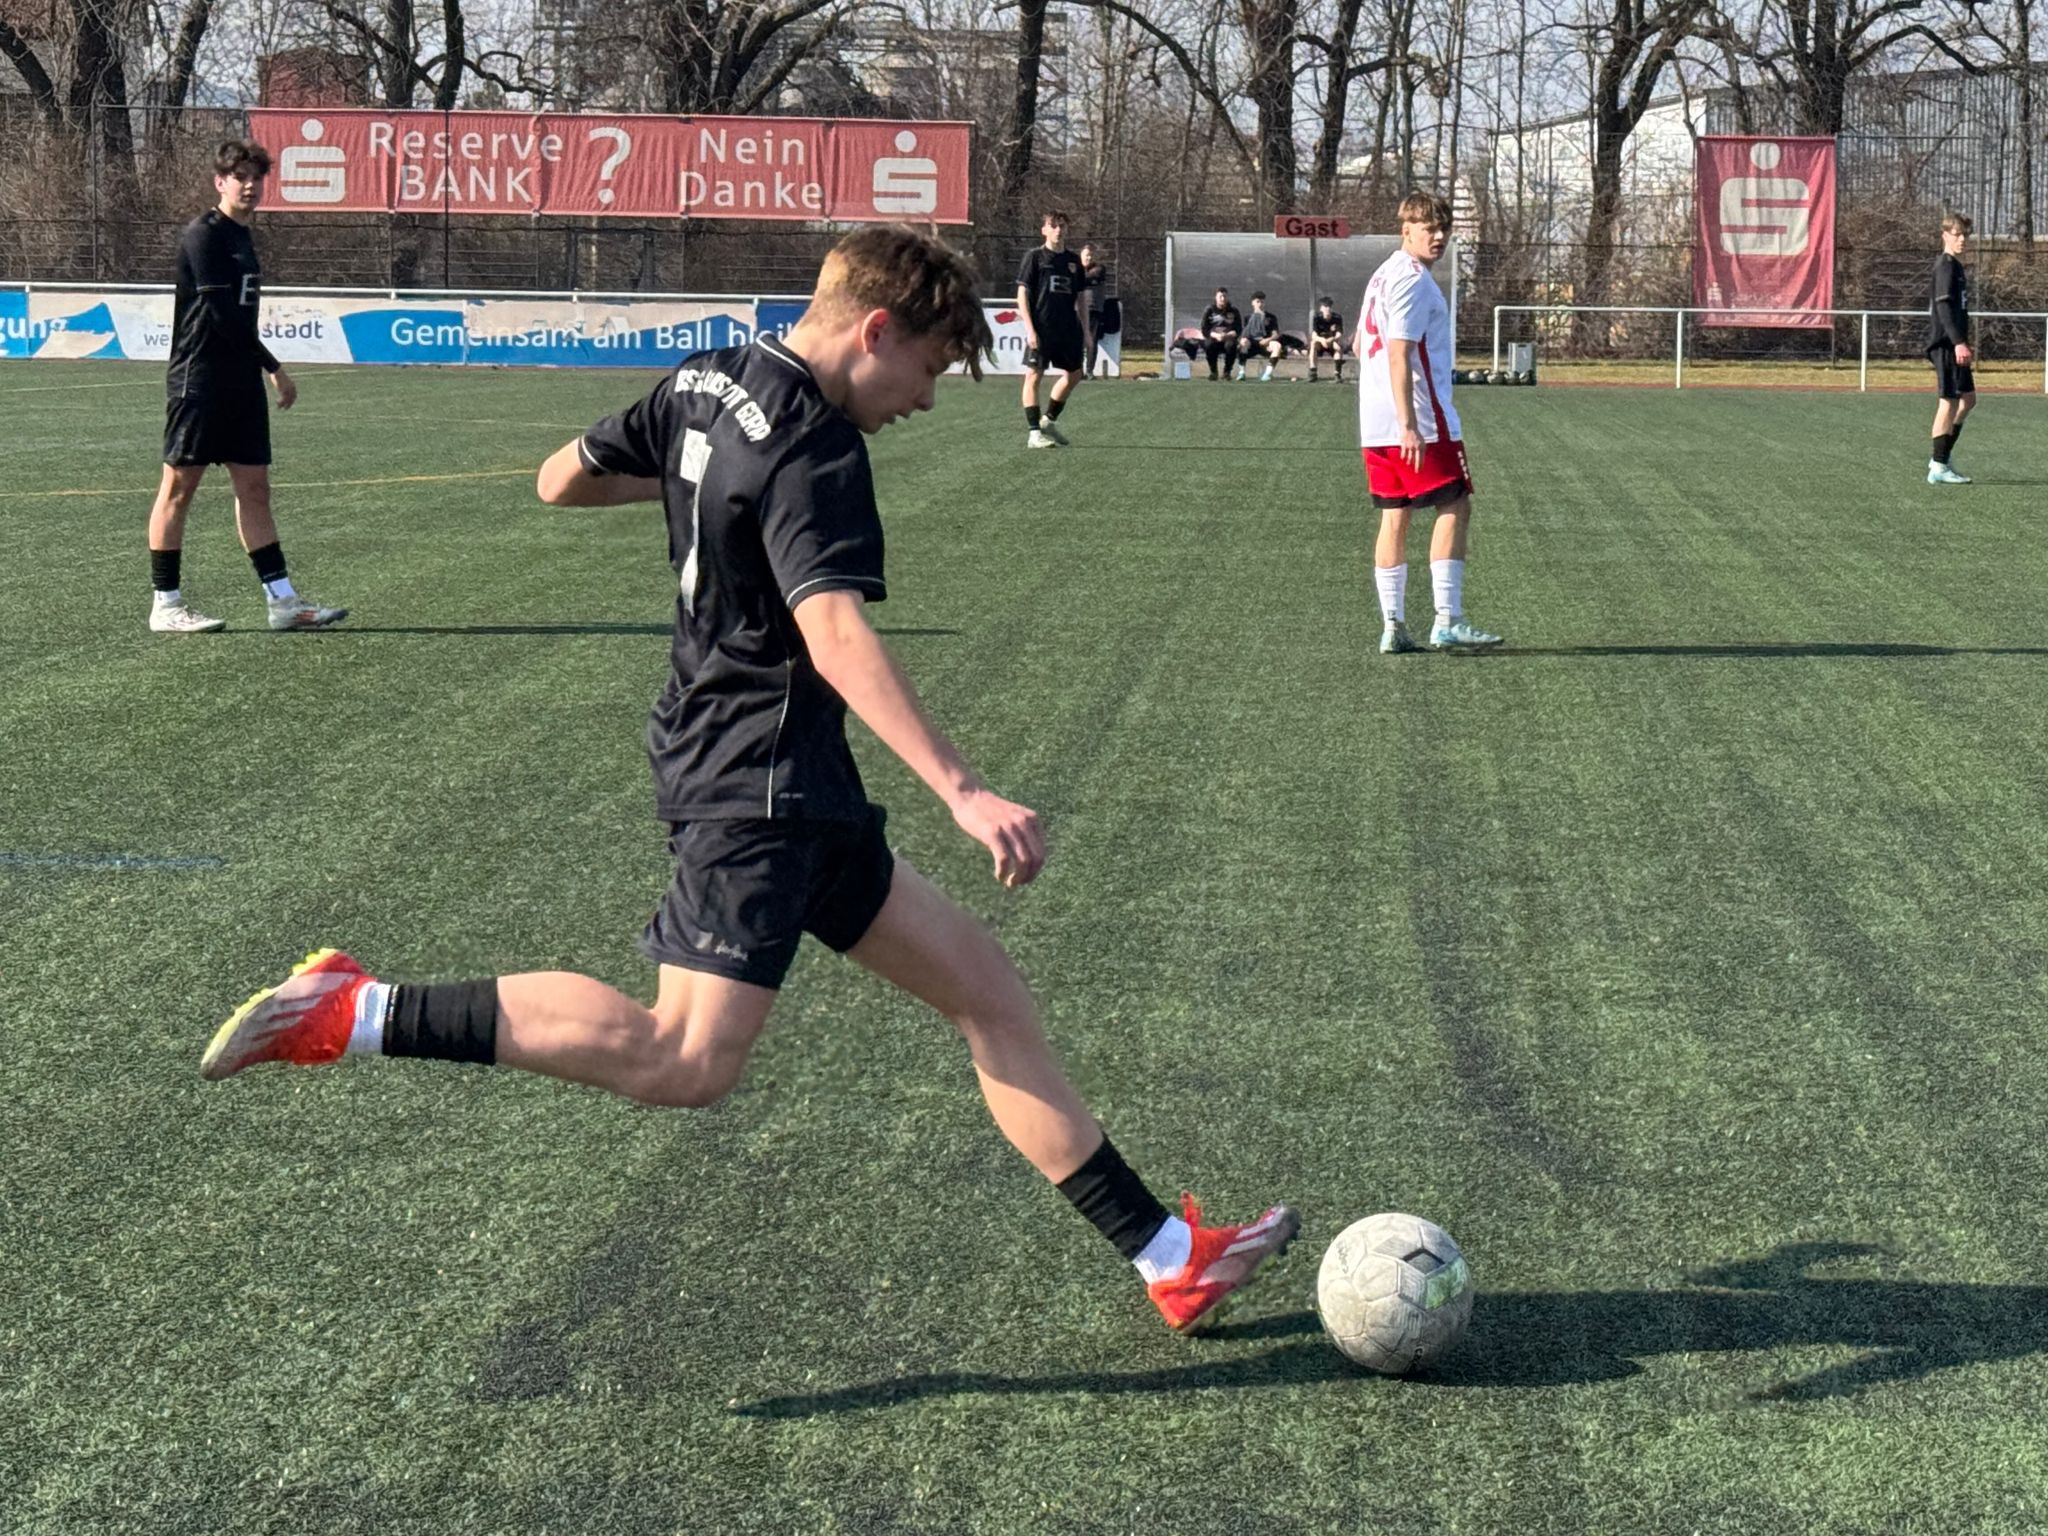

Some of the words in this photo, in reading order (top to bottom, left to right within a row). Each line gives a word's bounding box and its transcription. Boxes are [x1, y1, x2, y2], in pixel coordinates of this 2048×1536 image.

[367, 121, 564, 162] Reserve
[700, 128, 805, 165] Nein
[401, 165, 533, 203] BANK
[679, 171, 823, 209] Danke
[1285, 217, 1339, 237] Gast
[656, 321, 711, 349] Ball
